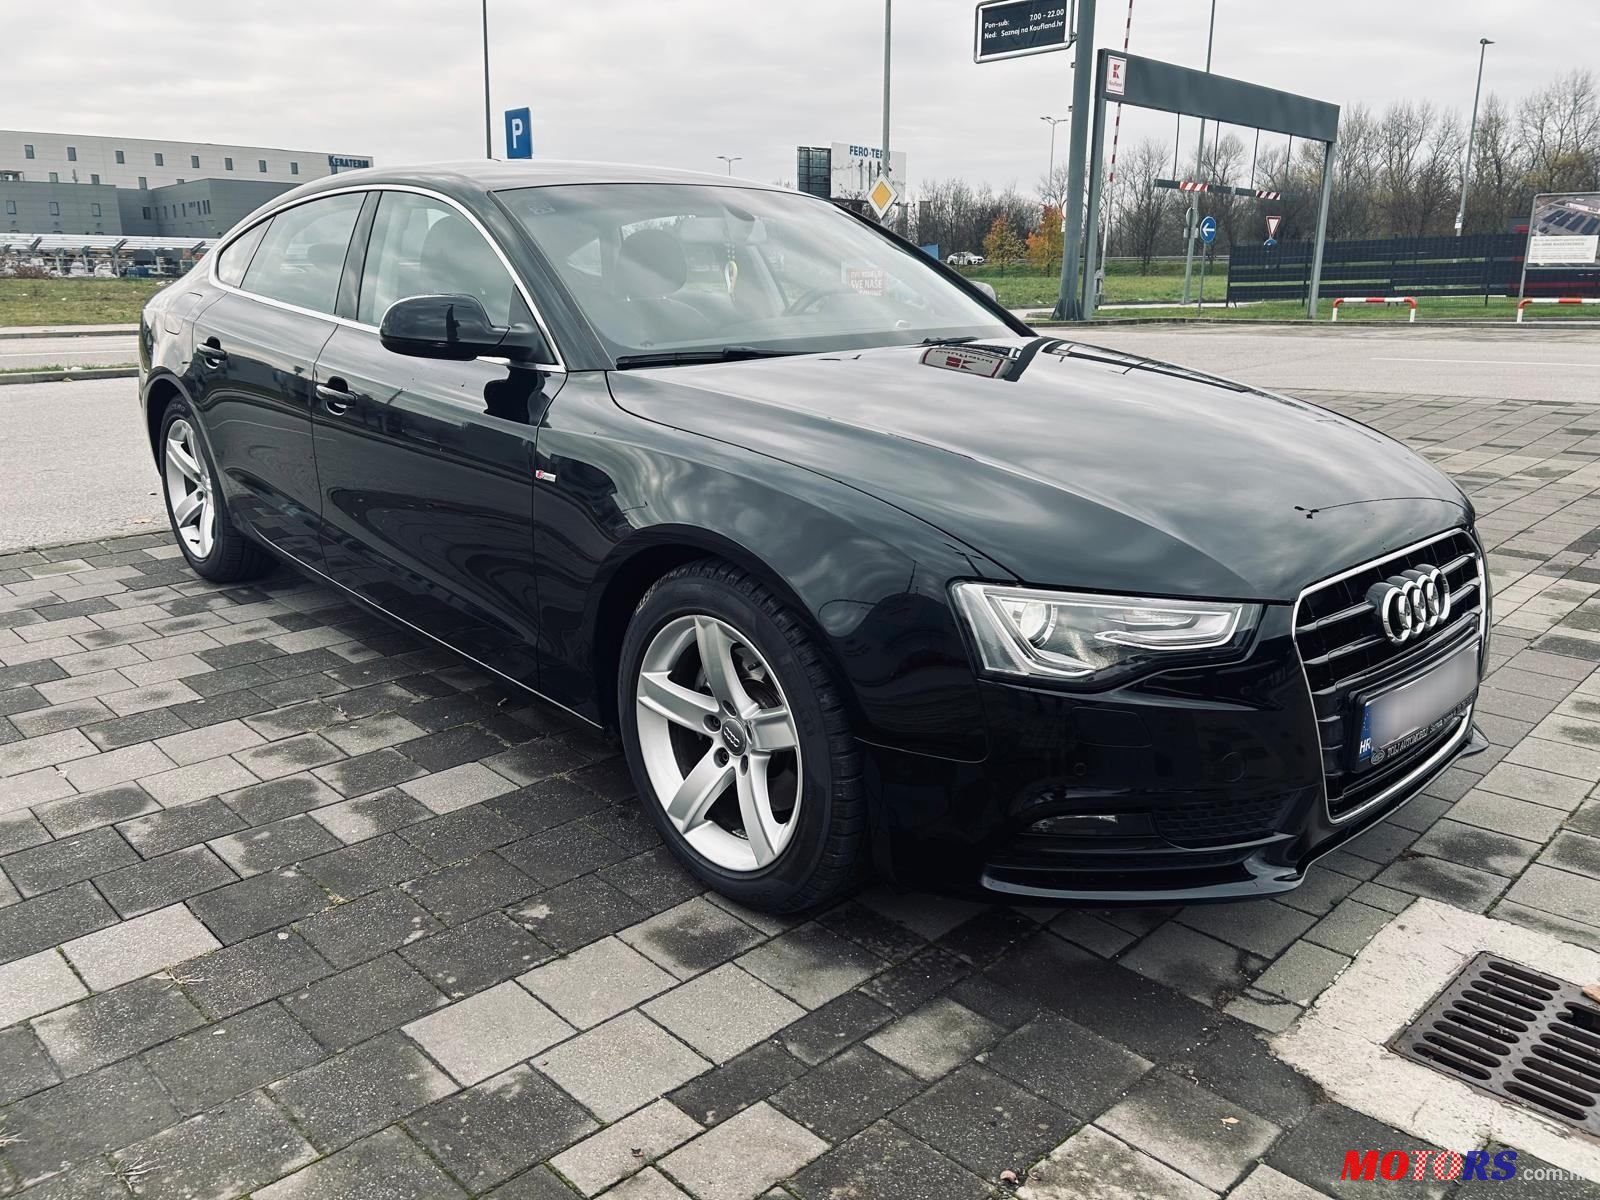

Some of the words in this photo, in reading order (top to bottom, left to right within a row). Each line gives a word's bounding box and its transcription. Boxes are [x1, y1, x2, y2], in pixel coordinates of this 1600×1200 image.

[985, 19, 1010, 29] Pon-sub:
[1047, 8, 1065, 18] 22.00
[1001, 27, 1020, 37] Saznaj
[1029, 20, 1064, 32] Kaufland.hr
[511, 118, 523, 149] P
[849, 145, 890, 161] FERO-TER
[1360, 737, 1371, 754] HR
